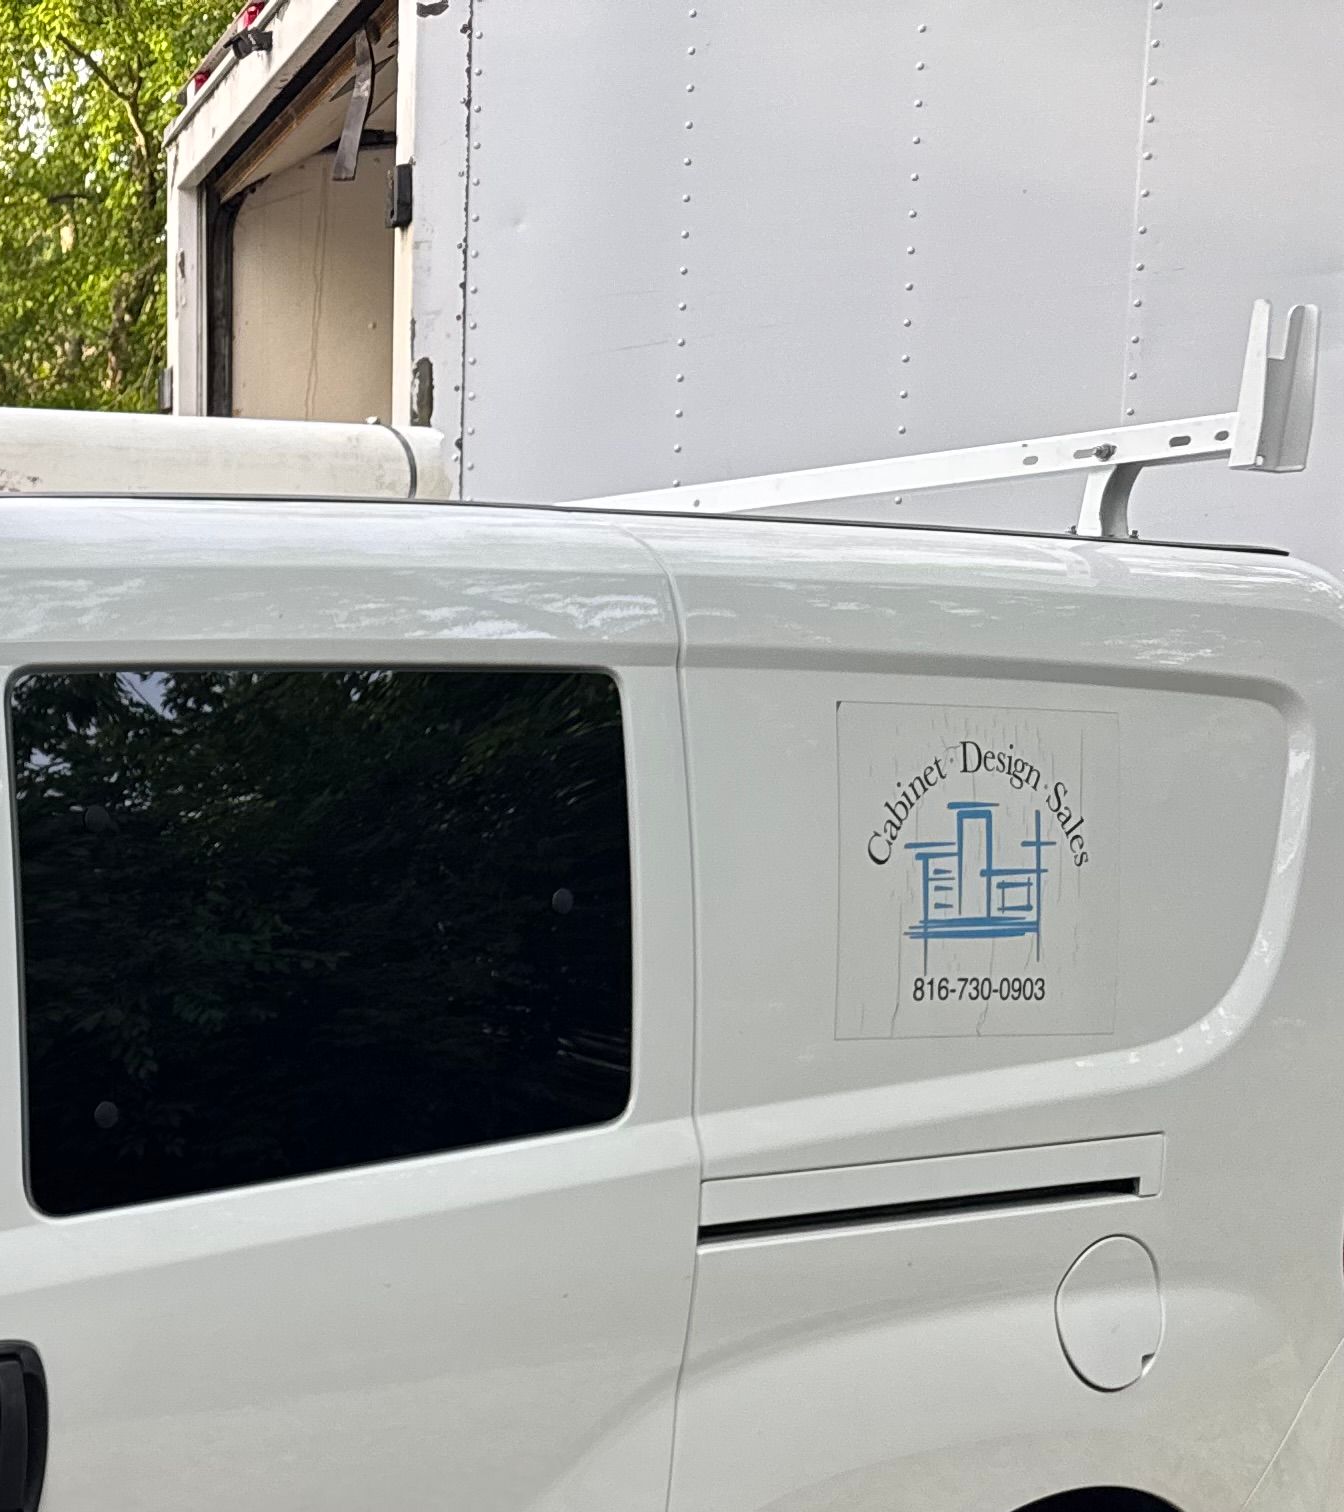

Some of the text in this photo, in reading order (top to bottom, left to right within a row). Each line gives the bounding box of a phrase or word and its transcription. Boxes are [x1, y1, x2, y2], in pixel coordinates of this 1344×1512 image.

[867, 740, 1089, 868] Cabinet Design Sales
[912, 977, 1046, 1001] 816-730-0903
